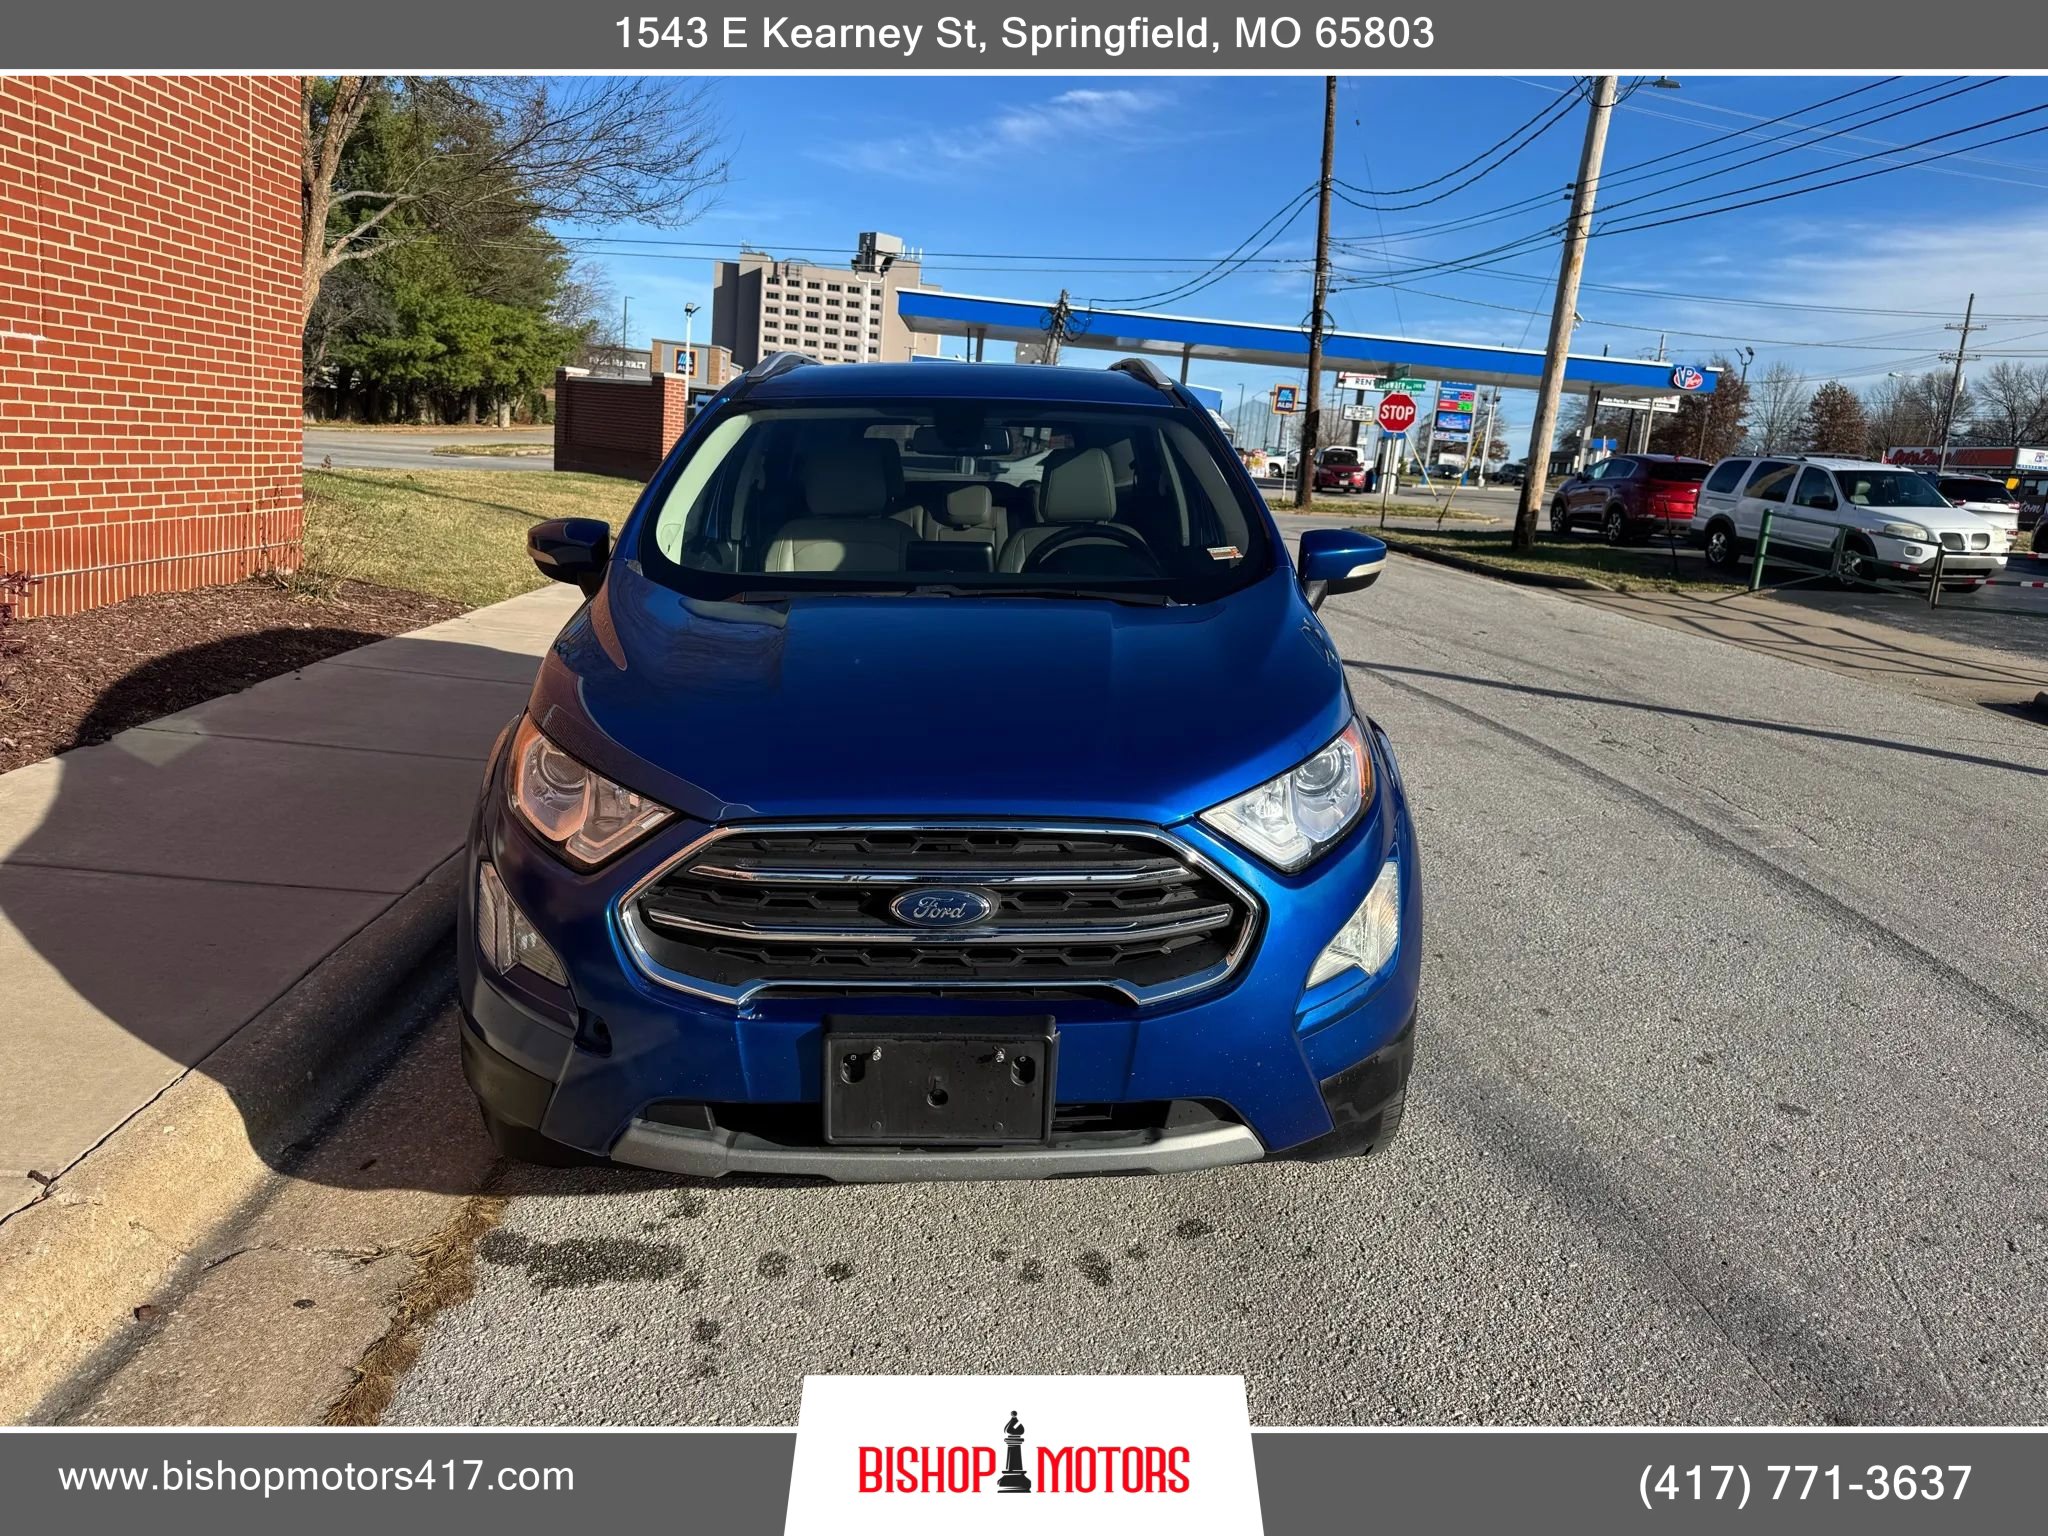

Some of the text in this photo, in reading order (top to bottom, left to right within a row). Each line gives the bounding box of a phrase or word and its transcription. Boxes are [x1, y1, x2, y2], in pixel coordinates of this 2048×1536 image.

[1676, 366, 1695, 388] VP
[1277, 401, 1293, 409] ALDI
[1380, 405, 1414, 420] STOP
[1892, 448, 1952, 465] AutoZoe
[913, 896, 966, 919] Ford
